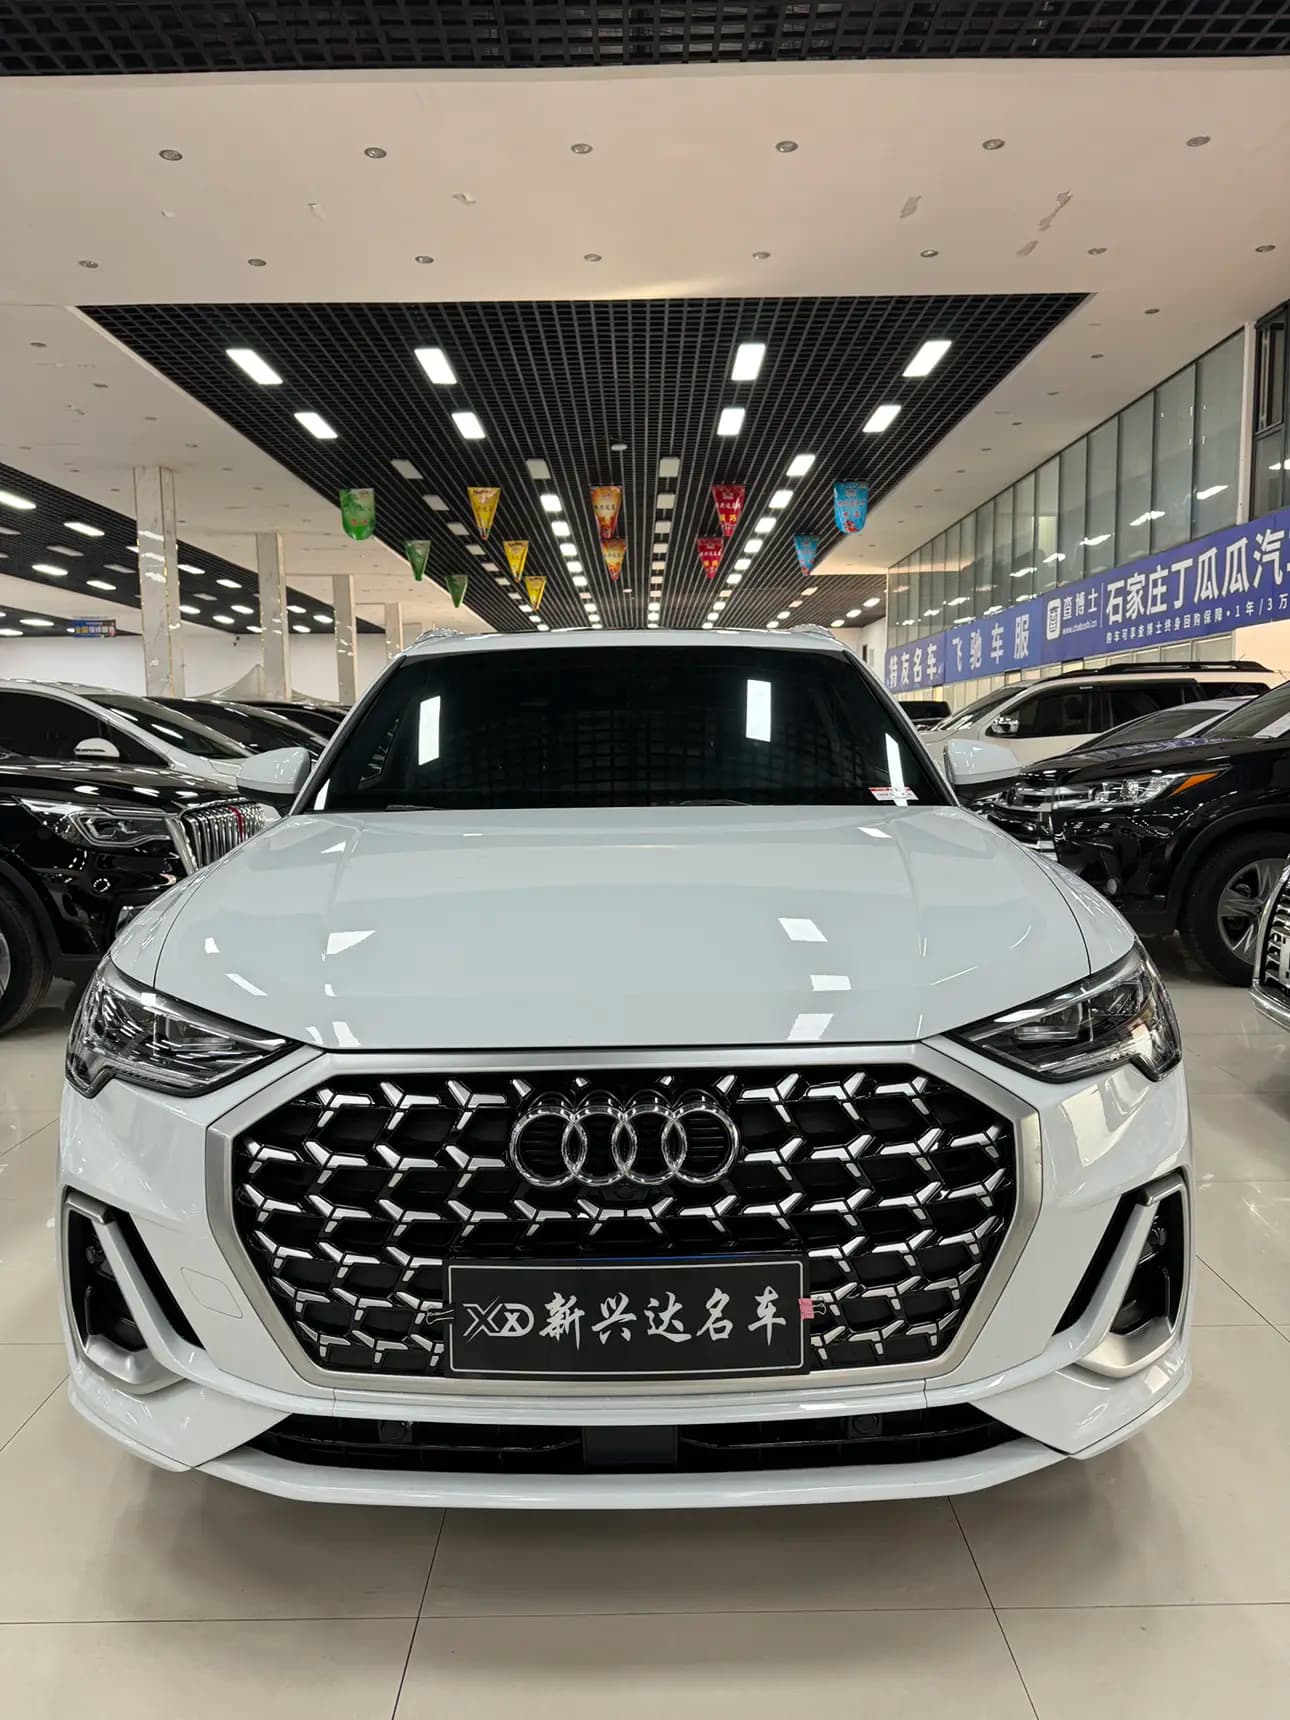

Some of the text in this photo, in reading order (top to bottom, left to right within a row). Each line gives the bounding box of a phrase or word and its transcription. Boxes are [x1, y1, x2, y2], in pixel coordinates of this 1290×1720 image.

[1063, 587, 1098, 620] 查博士
[1106, 529, 1290, 626] 石家庄丁瓜瓜汽
[951, 613, 1029, 673] 飞驰车服
[539, 1286, 786, 1350] 新兴达名车
